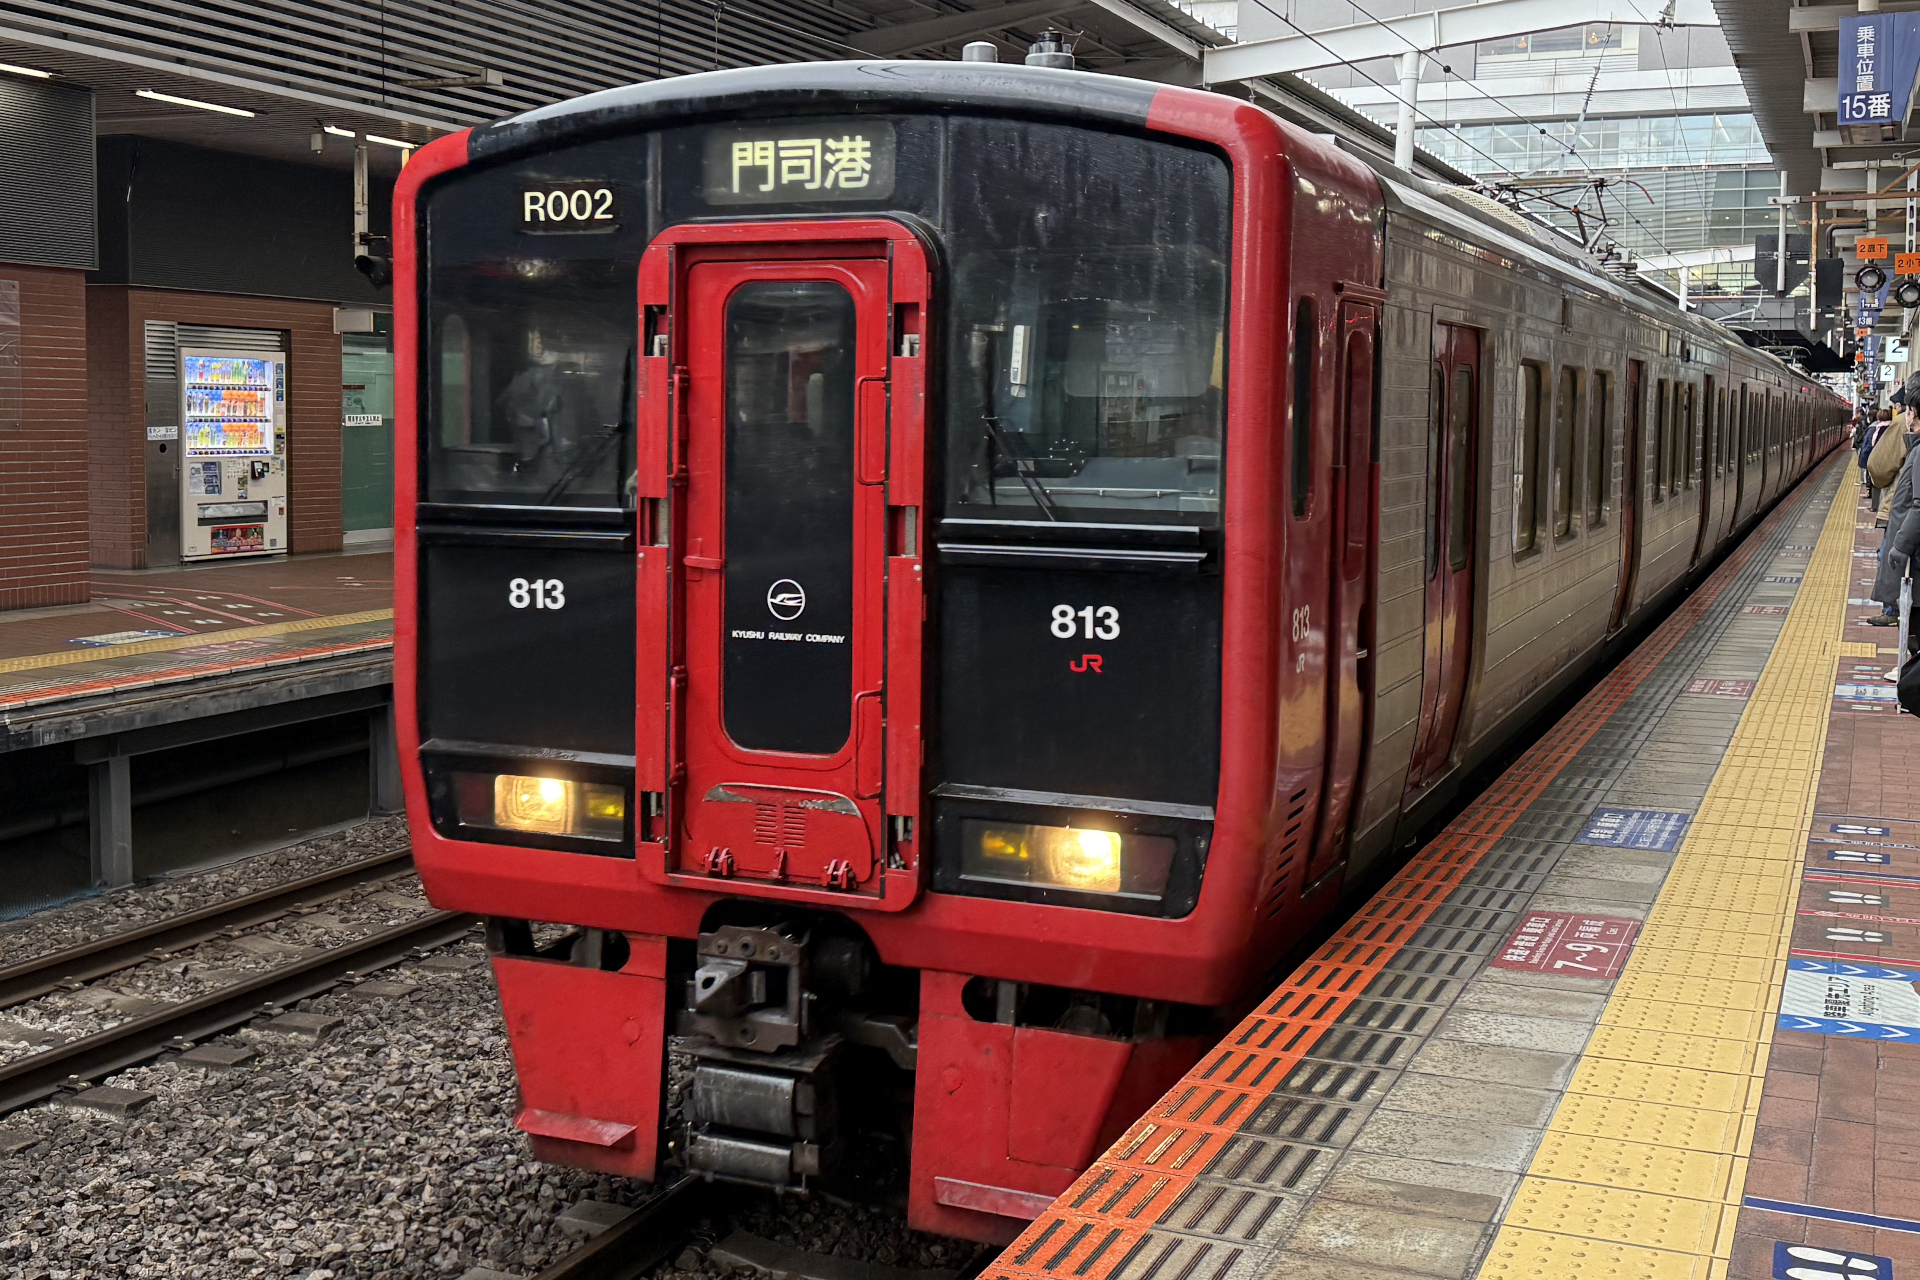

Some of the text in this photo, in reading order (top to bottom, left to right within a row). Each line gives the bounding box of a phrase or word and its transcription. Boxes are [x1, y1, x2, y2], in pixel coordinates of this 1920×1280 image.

[1856, 25, 1875, 92] 乗車位置
[1842, 93, 1891, 119] 15番
[732, 135, 872, 194] 門司港
[523, 188, 614, 222] R002
[1891, 338, 1903, 354] 2
[1884, 365, 1892, 376] 2
[508, 577, 566, 610] 813
[731, 630, 845, 644] KYUSHU RAILWAY COMPANY
[1050, 604, 1121, 641] 813
[1292, 604, 1310, 642] 813
[1069, 654, 1104, 674] JR
